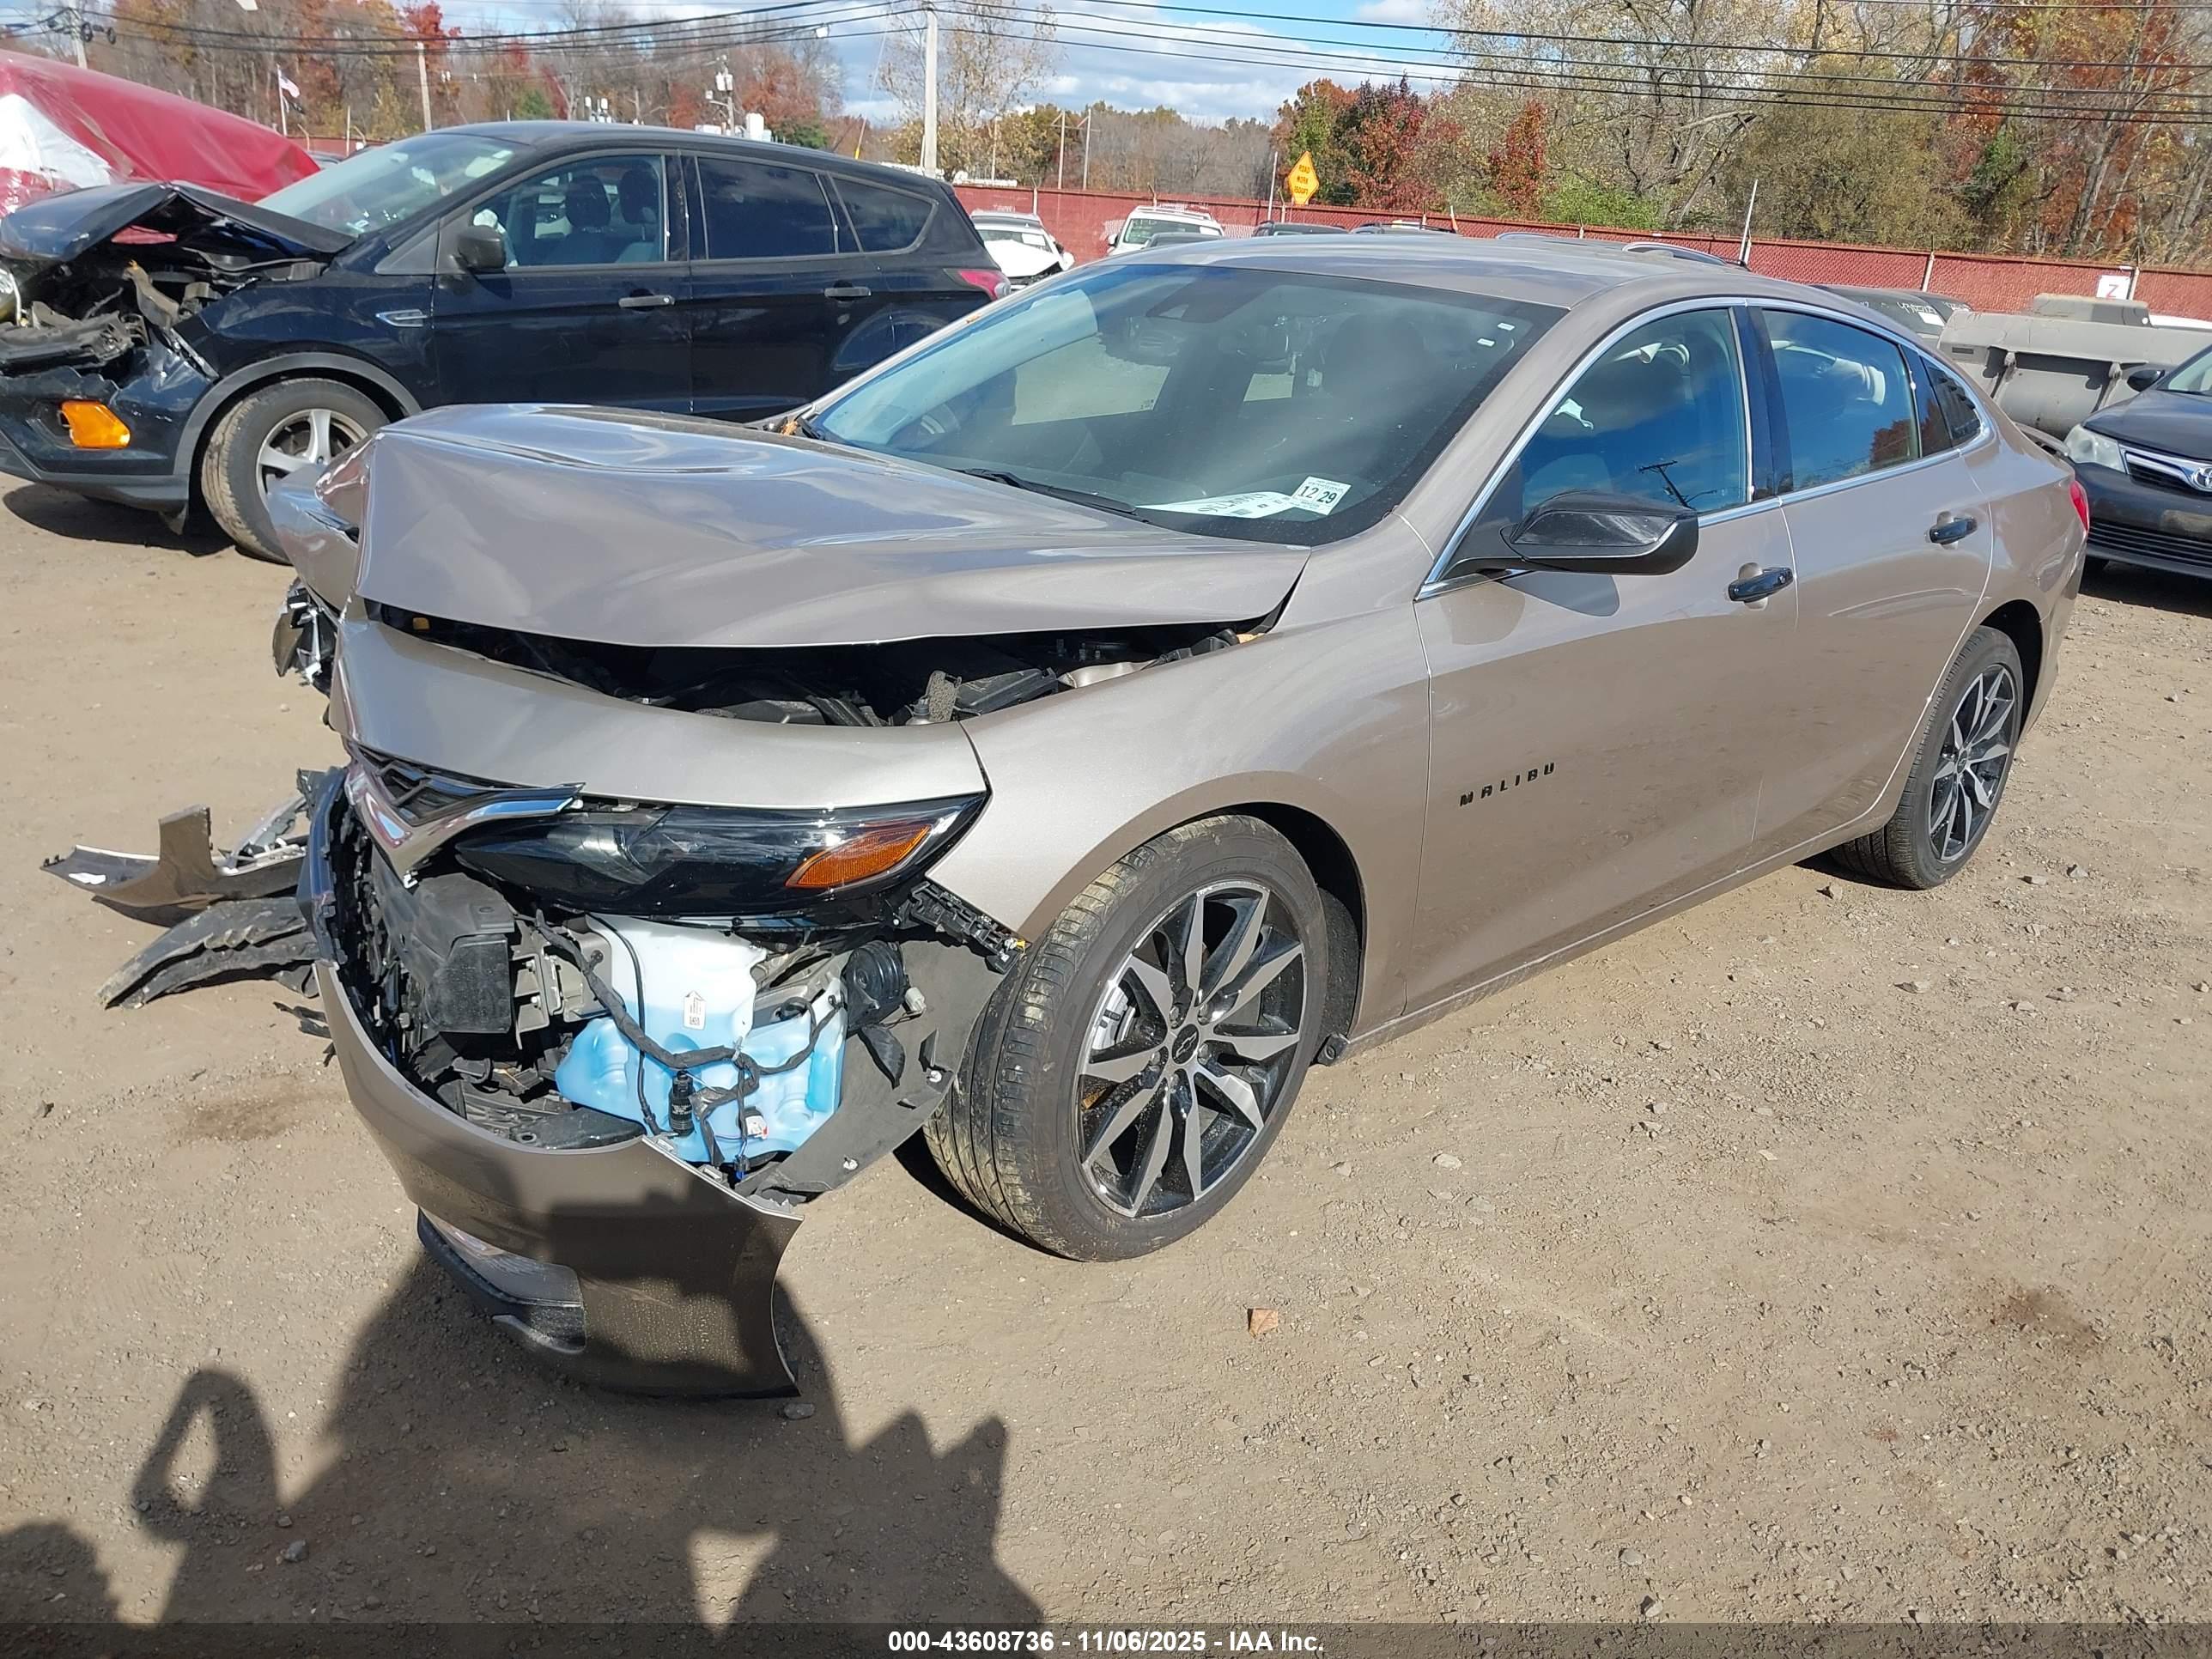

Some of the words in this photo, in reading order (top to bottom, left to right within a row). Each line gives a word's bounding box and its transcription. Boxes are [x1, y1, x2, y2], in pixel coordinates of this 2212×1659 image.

[2106, 283, 2118, 298] Z
[1297, 485, 1319, 499] 12
[1316, 491, 1338, 504] 29
[1460, 763, 1555, 807] MALIBU
